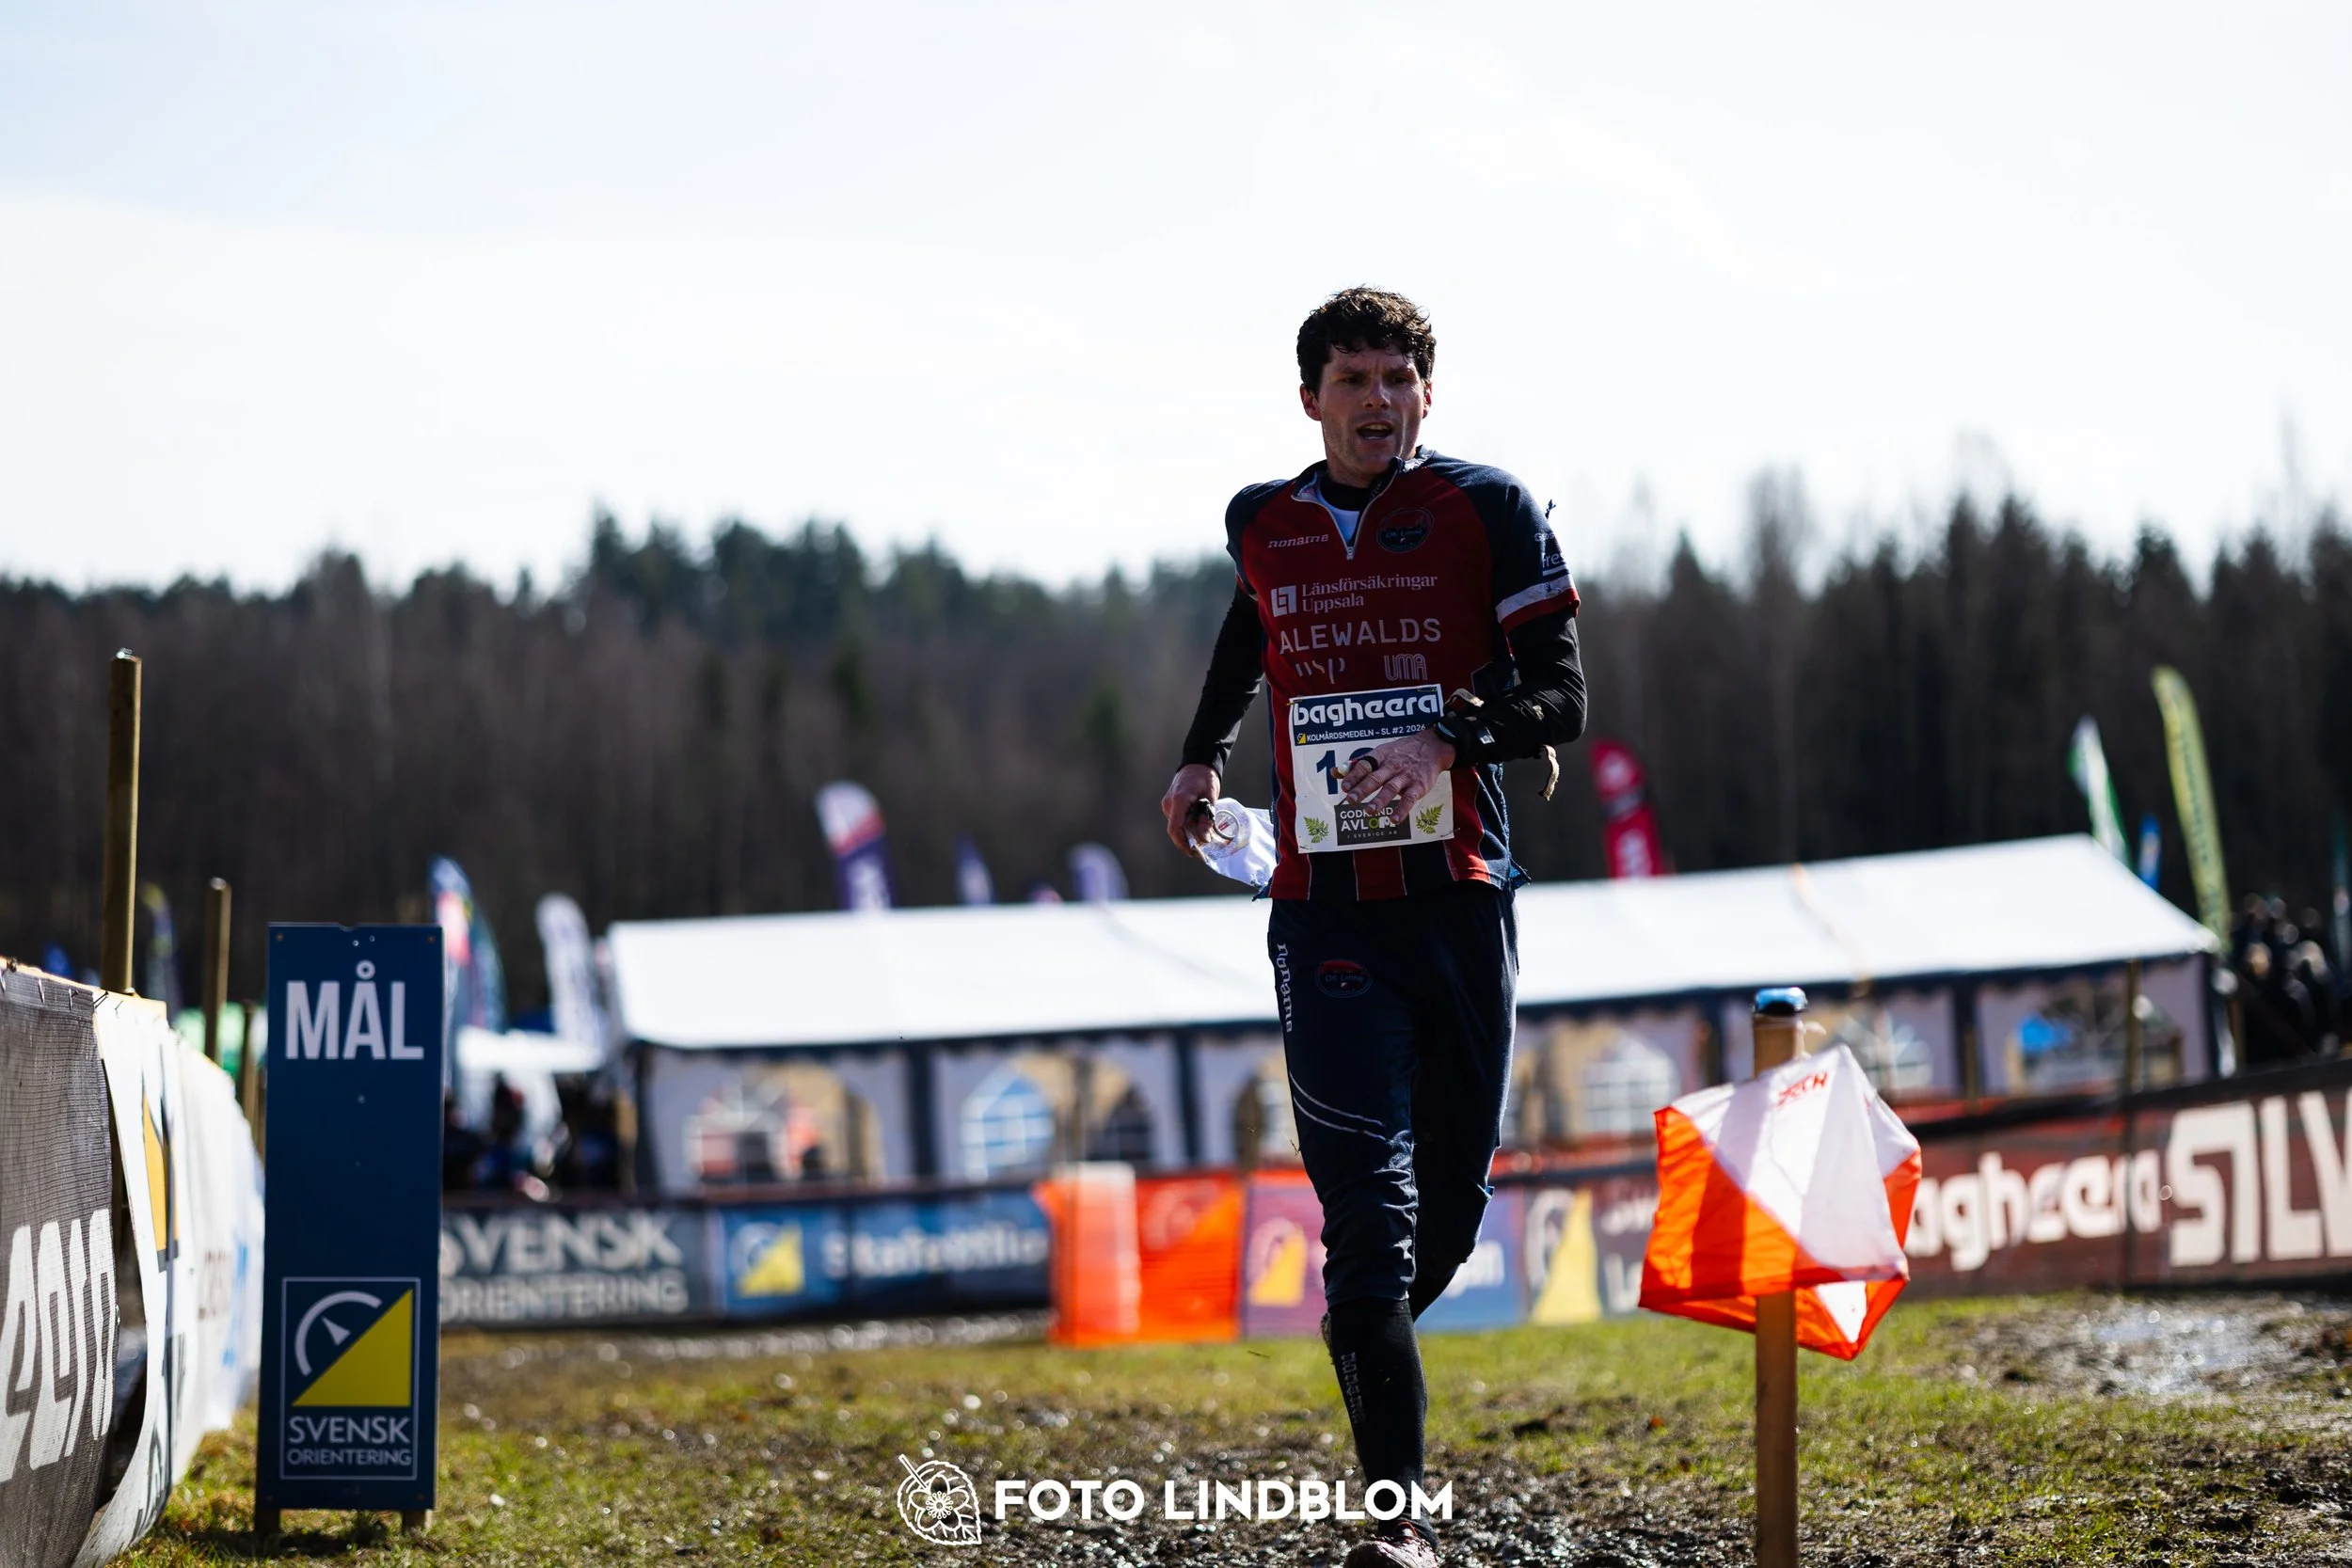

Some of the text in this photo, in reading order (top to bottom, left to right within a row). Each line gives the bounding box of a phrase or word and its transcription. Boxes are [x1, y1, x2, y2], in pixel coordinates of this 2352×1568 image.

[1267, 533, 1329, 548] noname
[1301, 574, 1438, 597] Länsförsäkringar
[1302, 593, 1365, 614] Uppsala
[1279, 617, 1442, 655] ALEWALDS
[1293, 694, 1438, 727] bagheera
[1307, 729, 1375, 743] KOLMÅRDSMEDELN
[1381, 727, 1391, 736] SL
[1392, 725, 1404, 734] #2
[1406, 723, 1426, 734] 2026
[285, 959, 425, 1060] MÅL
[288, 1415, 411, 1445] SVENSK
[286, 1448, 412, 1466] ORIENTERING
